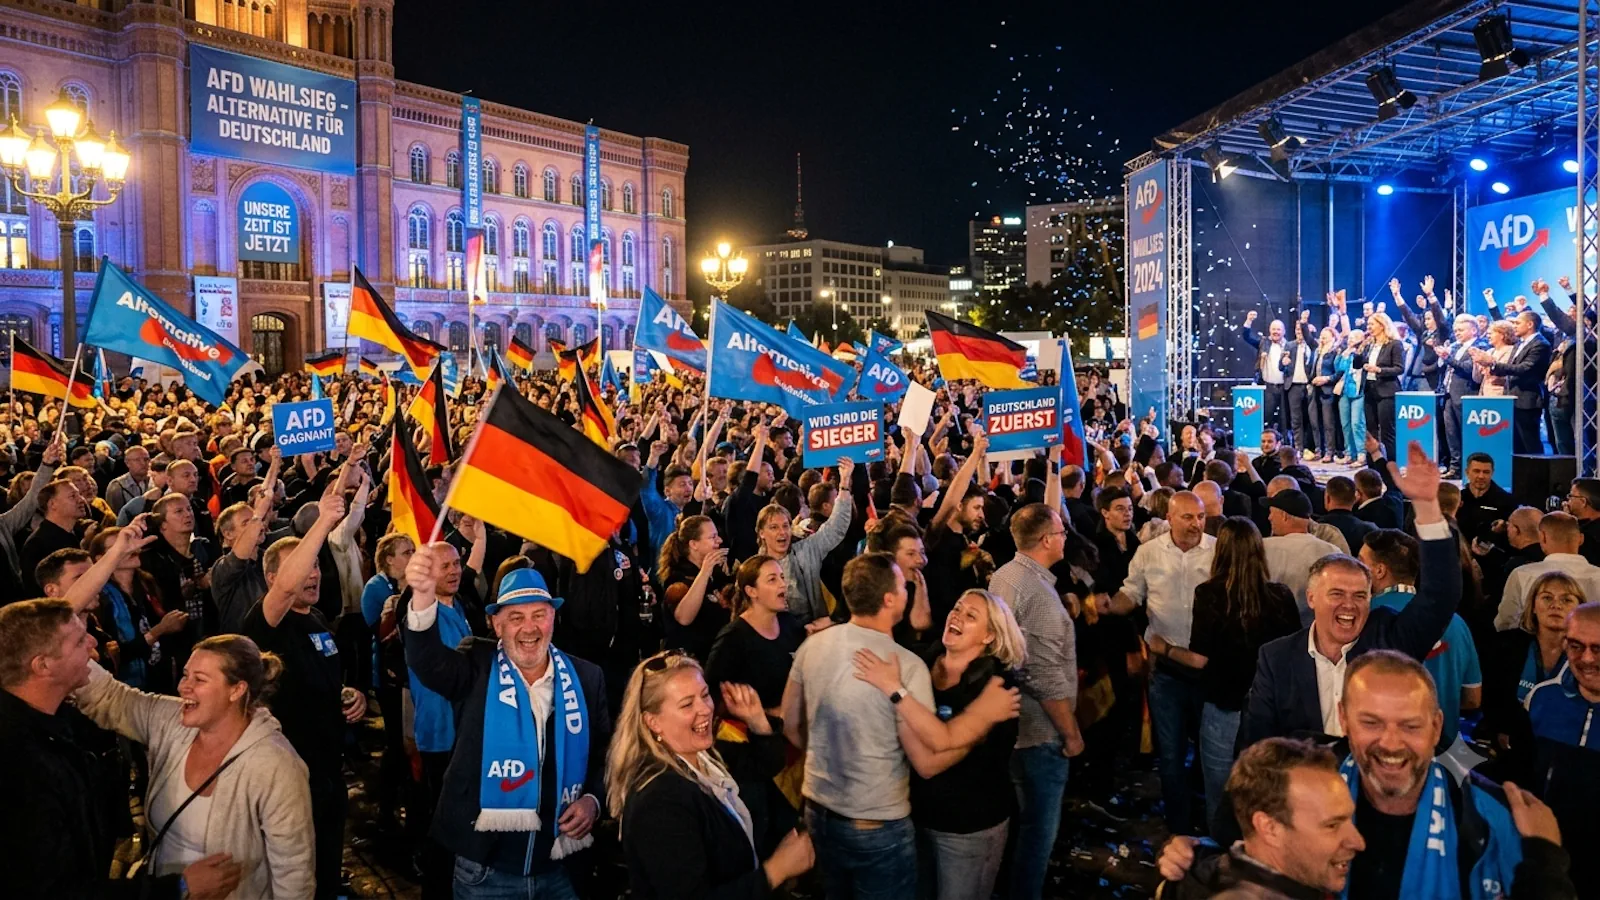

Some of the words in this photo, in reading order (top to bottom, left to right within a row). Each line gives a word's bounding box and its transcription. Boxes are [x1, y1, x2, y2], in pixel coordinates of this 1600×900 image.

[207, 67, 244, 94] AFD
[249, 75, 337, 112] WAHLSIEG
[207, 94, 312, 130] ALTERNATIVE
[316, 111, 344, 136] FÜR
[219, 118, 331, 155] DEUTSCHLAND
[244, 200, 291, 219] UNSERE
[243, 217, 271, 233] ZEIT
[272, 219, 292, 235] IST
[1479, 213, 1535, 252] AfD
[244, 233, 291, 253] JETZT
[1134, 258, 1164, 294] 2024
[860, 409, 878, 421] DIE
[988, 397, 1056, 415] DEUTSCHLAND
[1466, 408, 1502, 425] AfD
[285, 407, 326, 431] AFD
[989, 409, 1055, 434] ZUERST
[278, 427, 333, 445] GAGNANT
[811, 423, 877, 449] SIEGER
[487, 759, 526, 778] AfD
